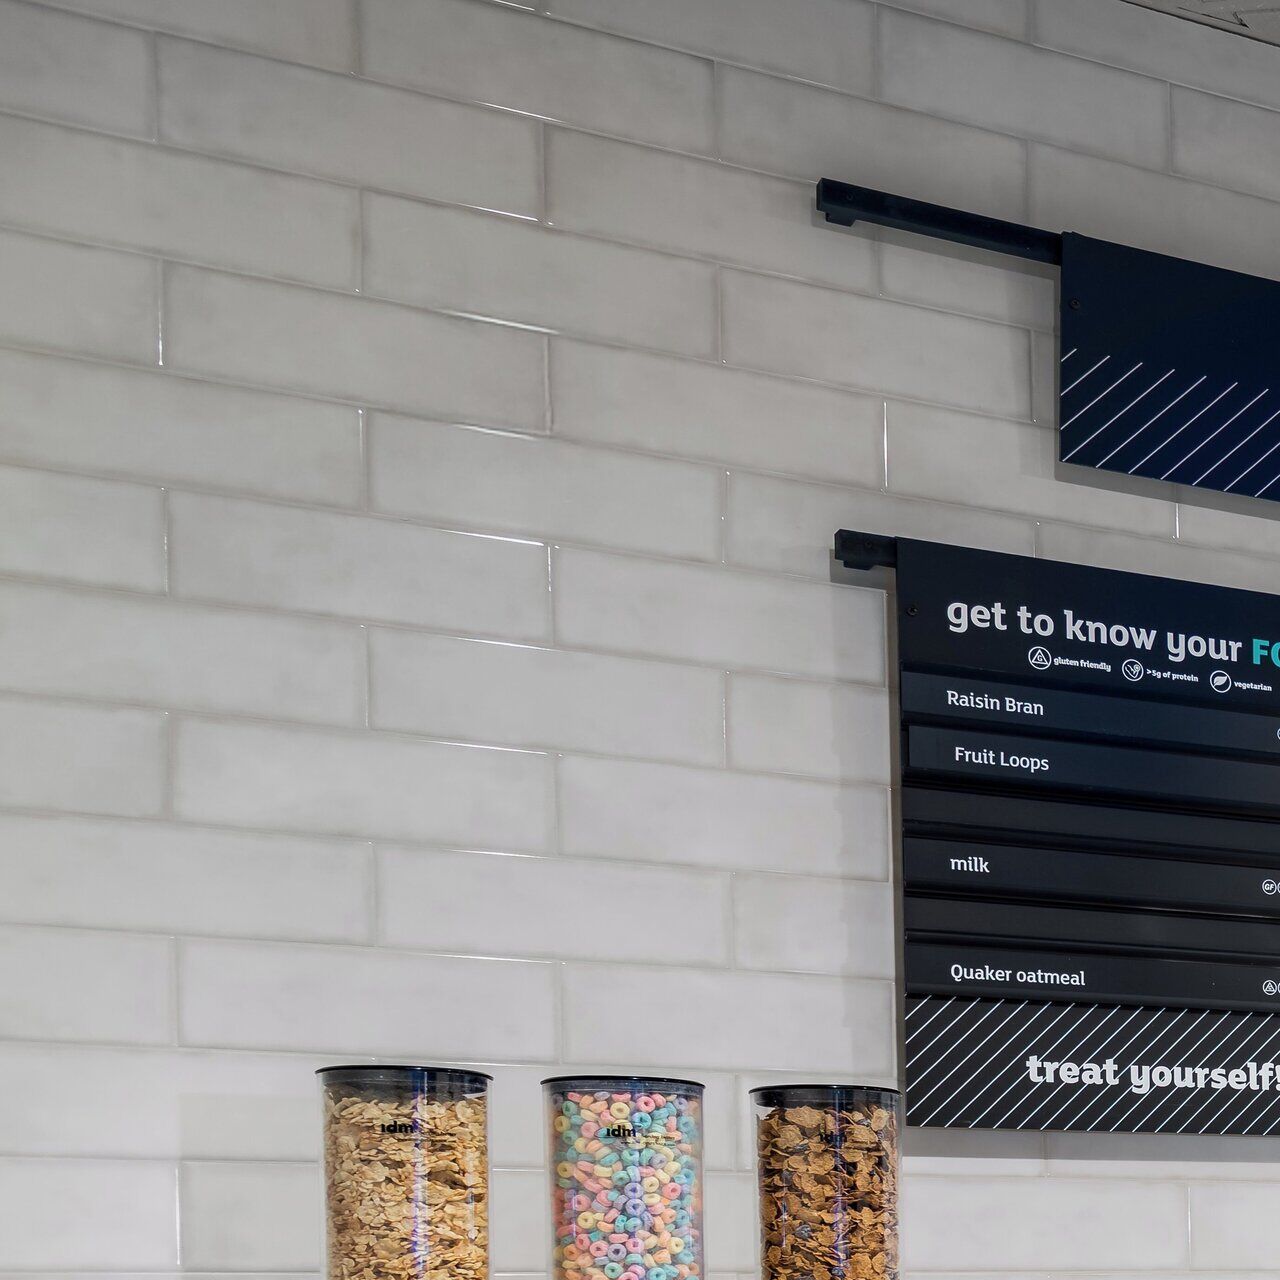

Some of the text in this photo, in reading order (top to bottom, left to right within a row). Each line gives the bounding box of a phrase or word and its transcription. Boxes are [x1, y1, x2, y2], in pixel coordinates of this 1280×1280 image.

[946, 602, 1008, 634] get
[1016, 605, 1055, 637] to
[1063, 609, 1158, 651] know
[1166, 631, 1243, 663] your
[1053, 656, 1112, 673] gluten friendly
[1163, 671, 1171, 680] of
[1171, 673, 1199, 684] protein
[1233, 680, 1273, 692] vegetarian
[946, 690, 1044, 716] Raisin Bran
[955, 746, 1050, 774] Fruit Loops
[949, 856, 990, 873] milk
[950, 964, 1086, 987] Quaker oatmeal
[1025, 1054, 1119, 1086] treat
